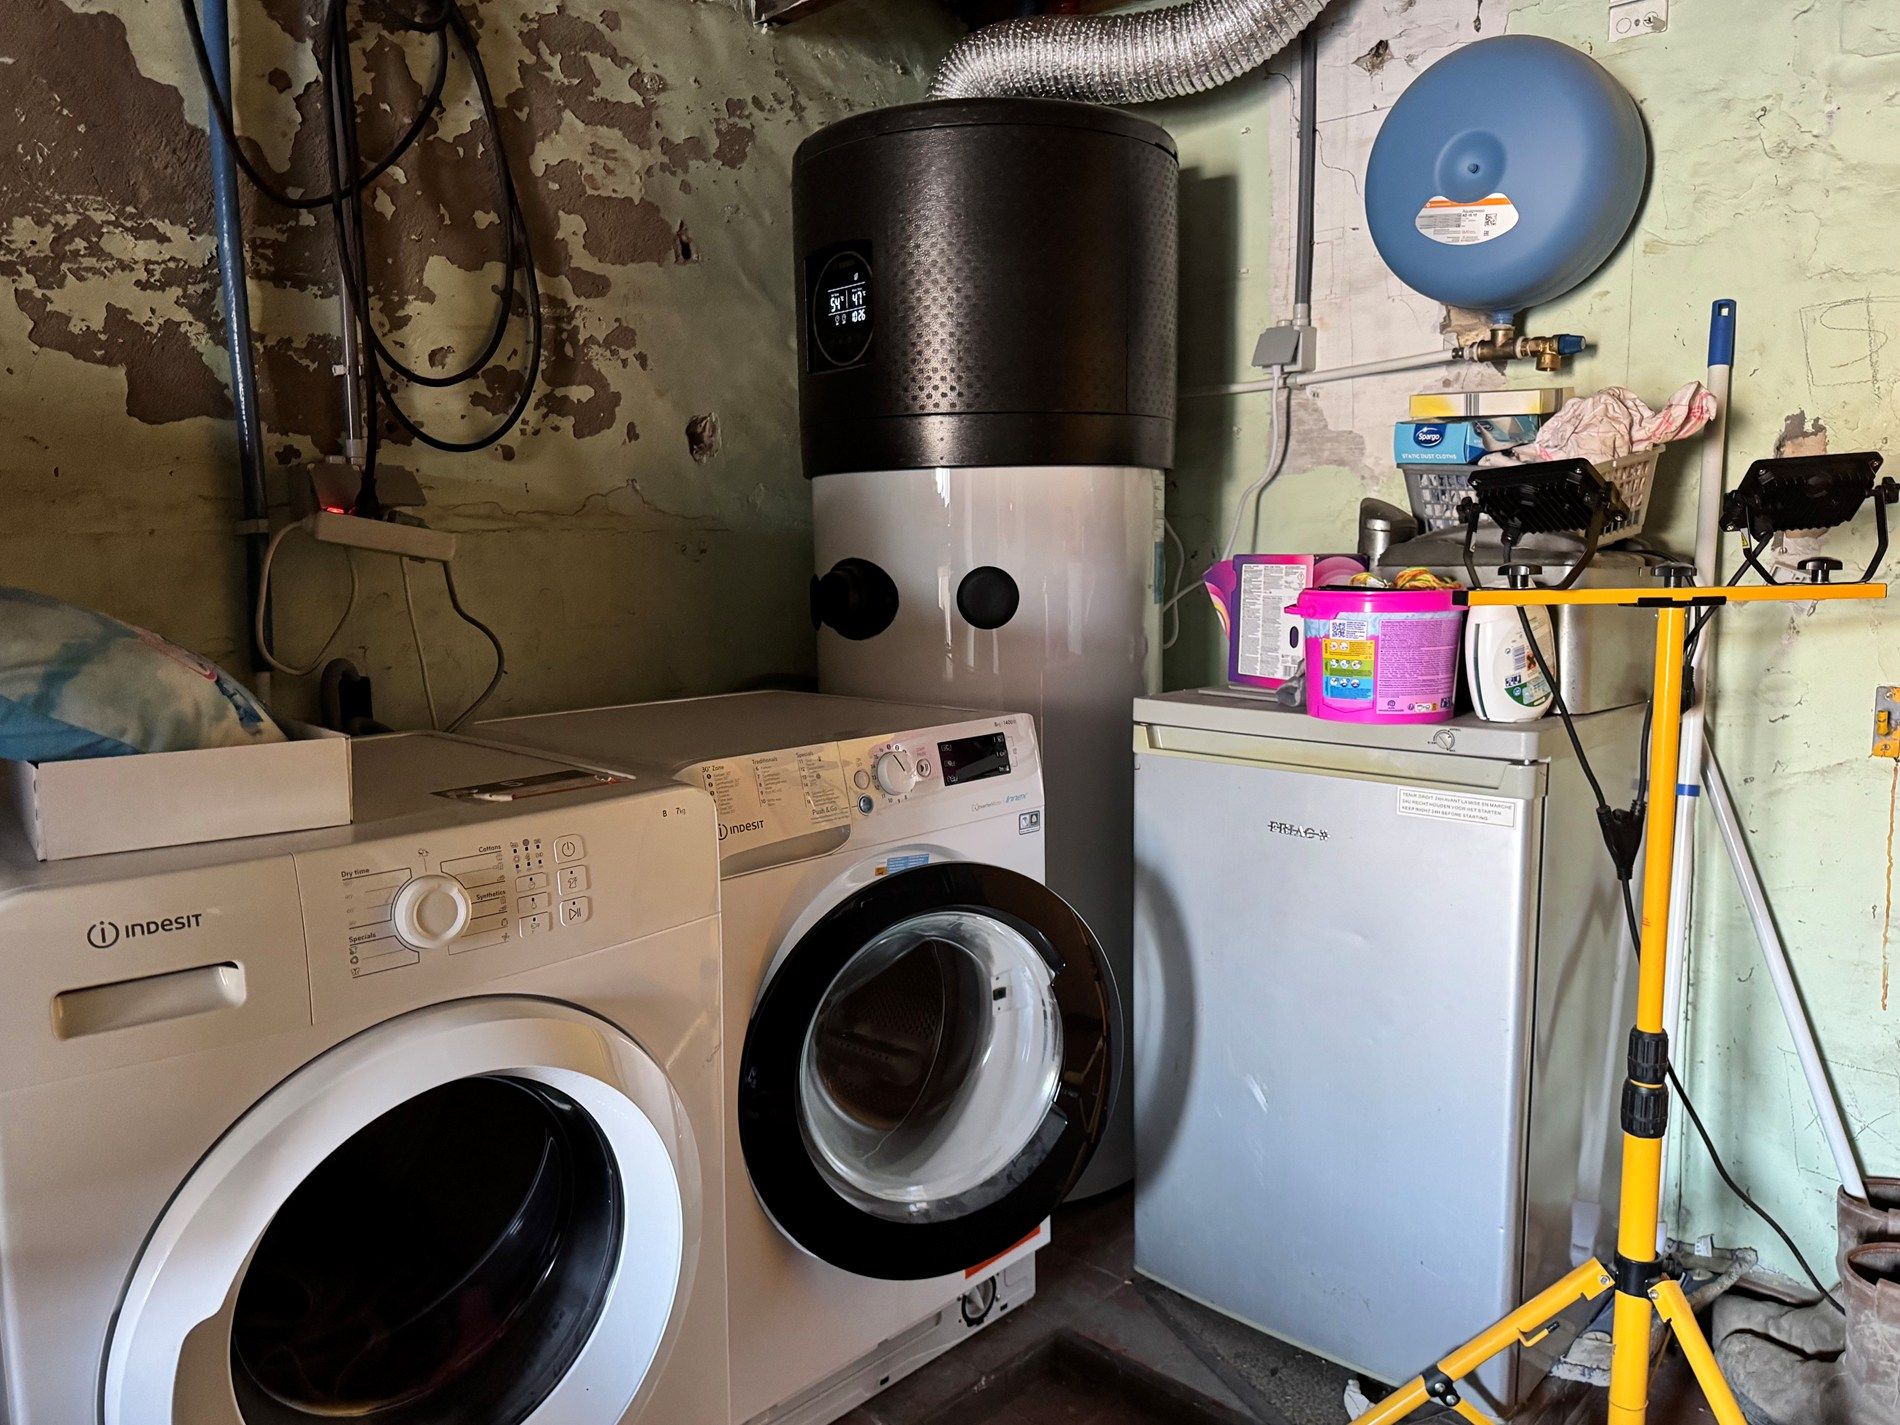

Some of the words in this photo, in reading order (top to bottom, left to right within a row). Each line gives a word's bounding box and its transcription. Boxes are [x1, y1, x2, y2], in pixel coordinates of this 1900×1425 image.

[1418, 432, 1440, 442] Spargo
[478, 844, 502, 853] Cottons
[341, 870, 353, 878] Dry
[476, 889, 506, 901] Synthetics
[124, 913, 202, 938] INDESIT
[348, 933, 377, 943] Specials
